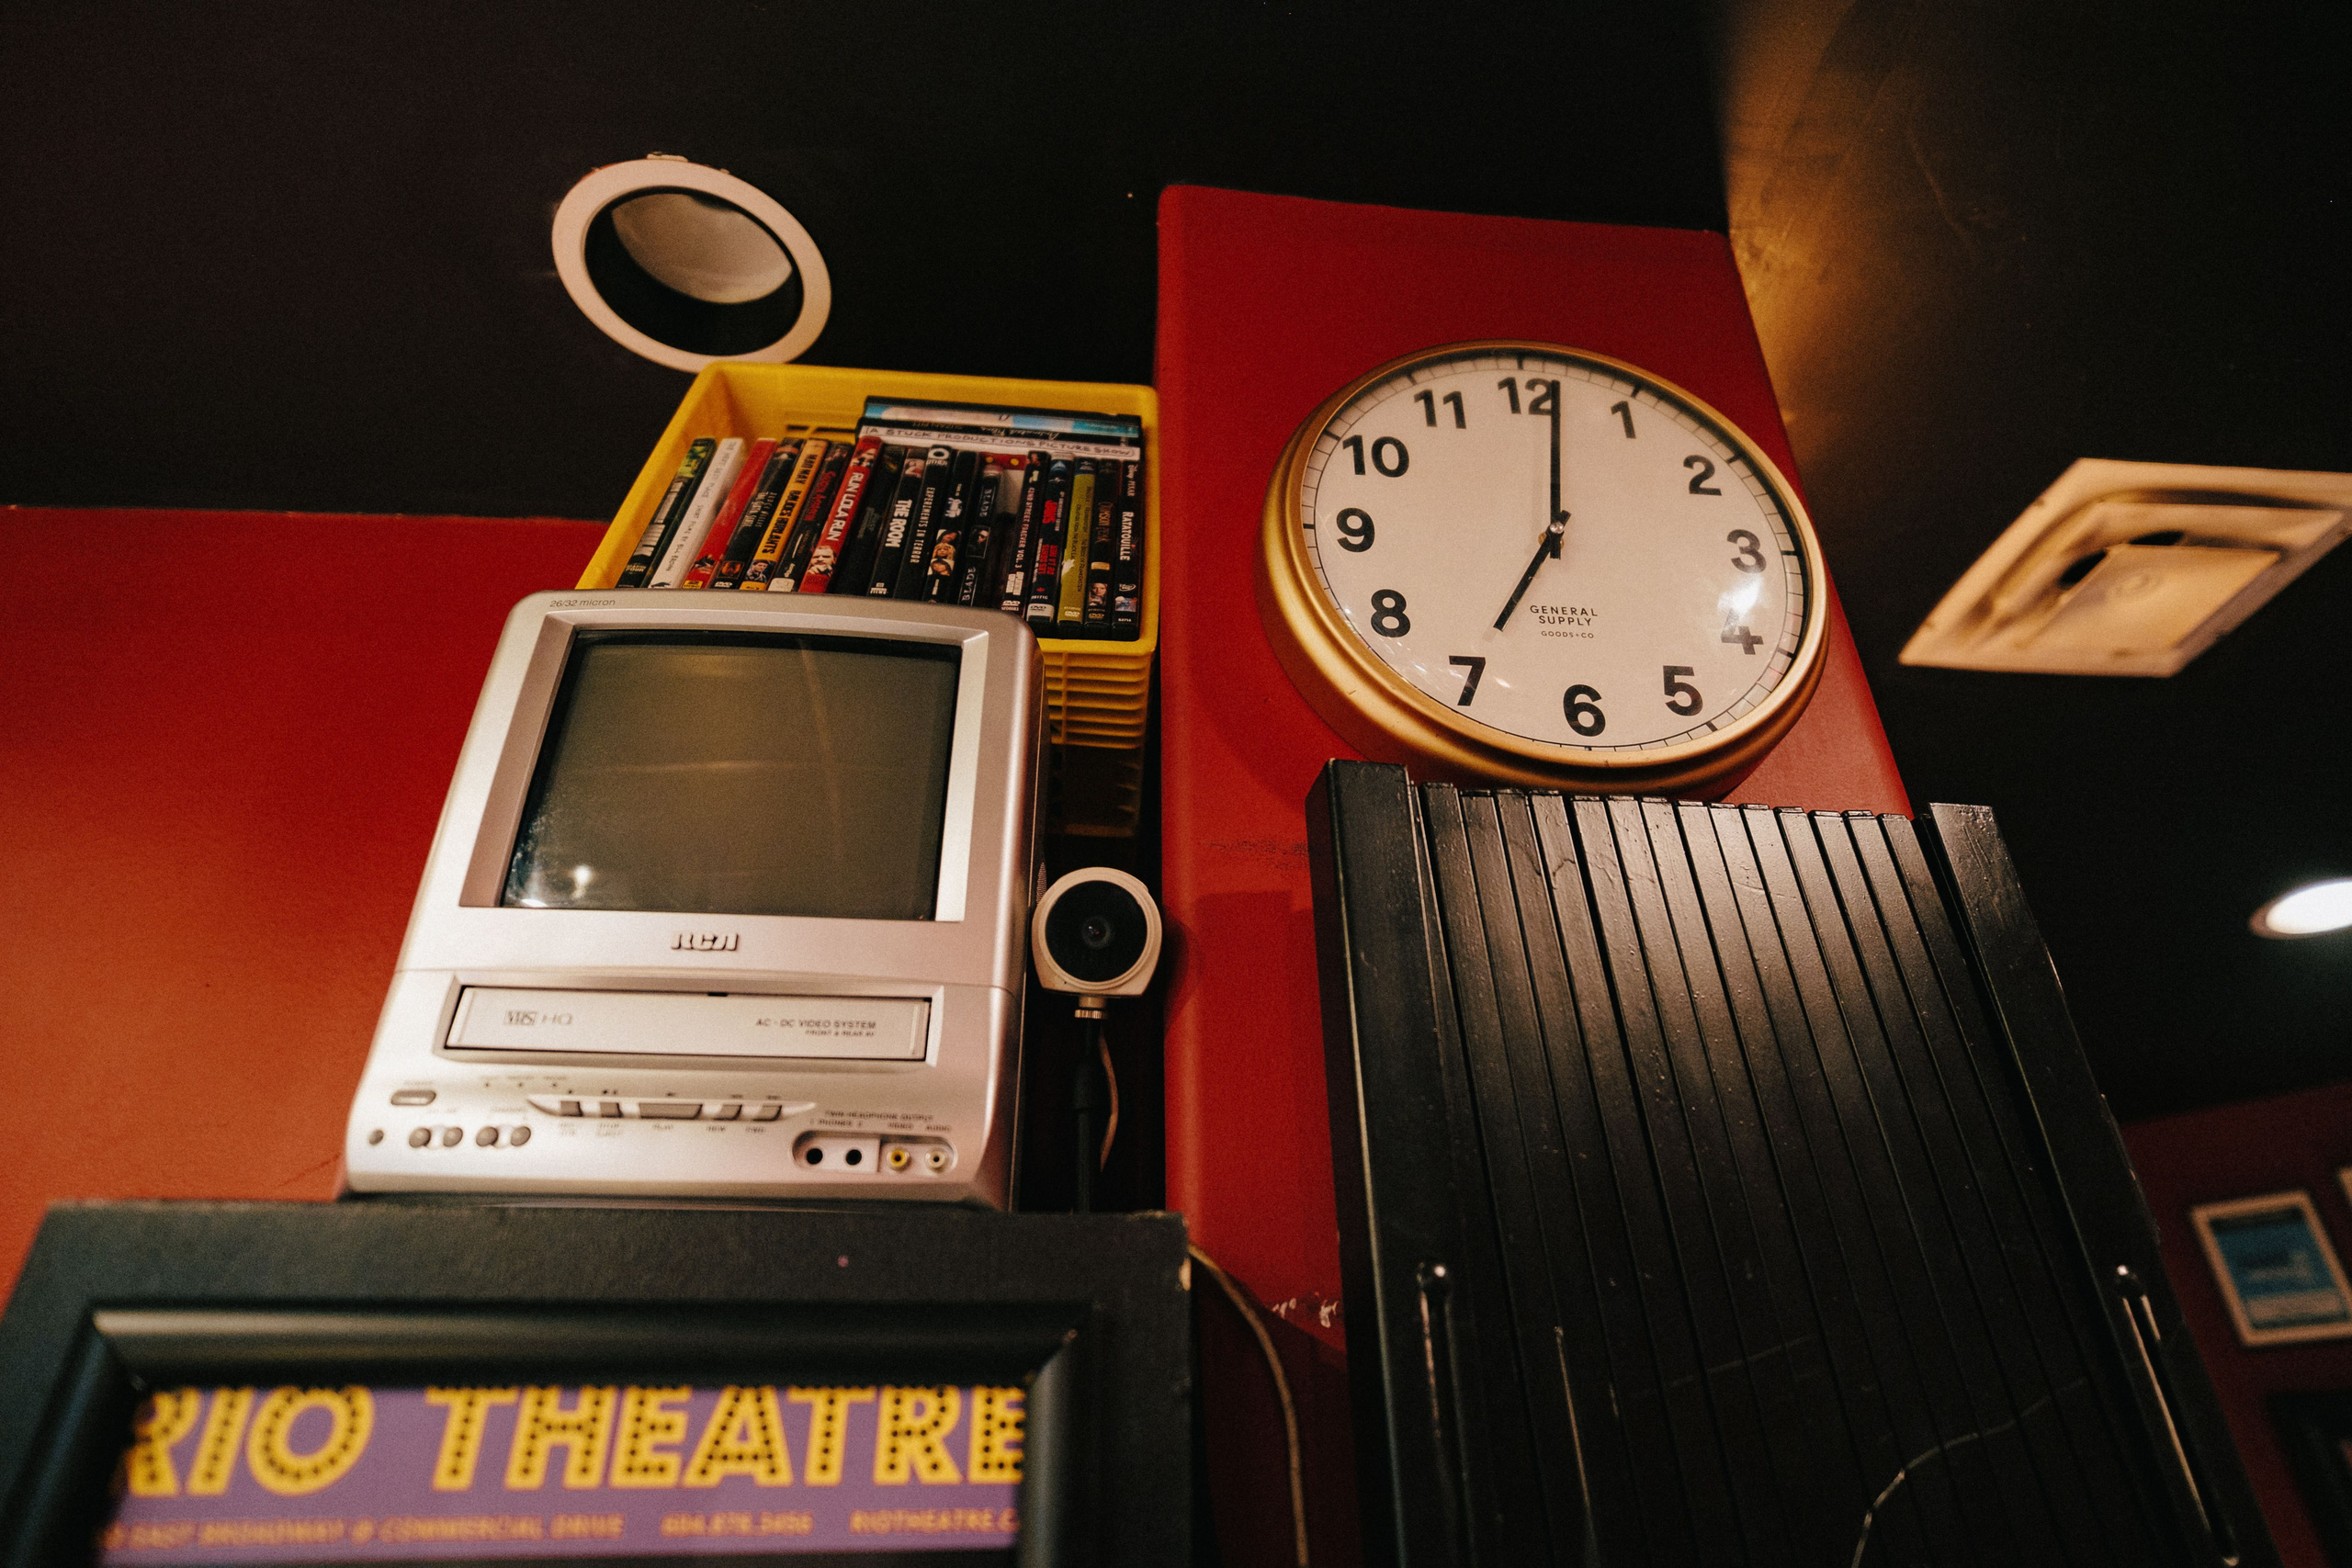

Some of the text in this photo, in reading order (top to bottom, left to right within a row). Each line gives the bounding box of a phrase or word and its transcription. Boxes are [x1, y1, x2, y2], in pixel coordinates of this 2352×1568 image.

[1413, 389, 1468, 430] 11
[1497, 377, 1555, 416] 12
[1610, 400, 1638, 439] 1
[886, 428, 932, 437] STUCK
[937, 433, 1035, 446] PRODUCTIONS
[1038, 440, 1091, 452] PICTURE
[1341, 434, 1410, 479] 10
[801, 454, 818, 468] MAD
[1125, 463, 1137, 497] Disney PIXAR
[1682, 455, 1723, 497] 2
[826, 471, 865, 541] RUN LOLA RUN
[979, 489, 993, 517] BLADE
[1022, 501, 1034, 525] STREET
[1098, 501, 1114, 526] CRIMSON
[762, 516, 790, 554] HURLANTS
[885, 499, 913, 548] THE ROOM
[910, 487, 936, 564] EXPERIMENTS IN TERROR
[1017, 524, 1030, 548] FOREVER
[1119, 511, 1136, 561] RATATOUILLE
[1336, 507, 1376, 553] 9
[1725, 529, 1768, 574] 3
[961, 566, 977, 602] BLADE
[1078, 562, 1086, 592] FRANKENSTEIN
[549, 598, 616, 608] 26/32 micron
[1370, 589, 1412, 638] 8
[1530, 604, 1599, 617] GENERAL
[1538, 615, 1592, 626] SUPPLY
[1721, 608, 1764, 655] 4
[1448, 655, 1487, 707] 7
[1662, 665, 1703, 716] 5
[1563, 683, 1607, 737] 6
[671, 931, 740, 952] RCA
[797, 1019, 831, 1029] VIDEO
[832, 1020, 876, 1030] SYSTEM
[425, 1384, 1026, 1491] THEATRE
